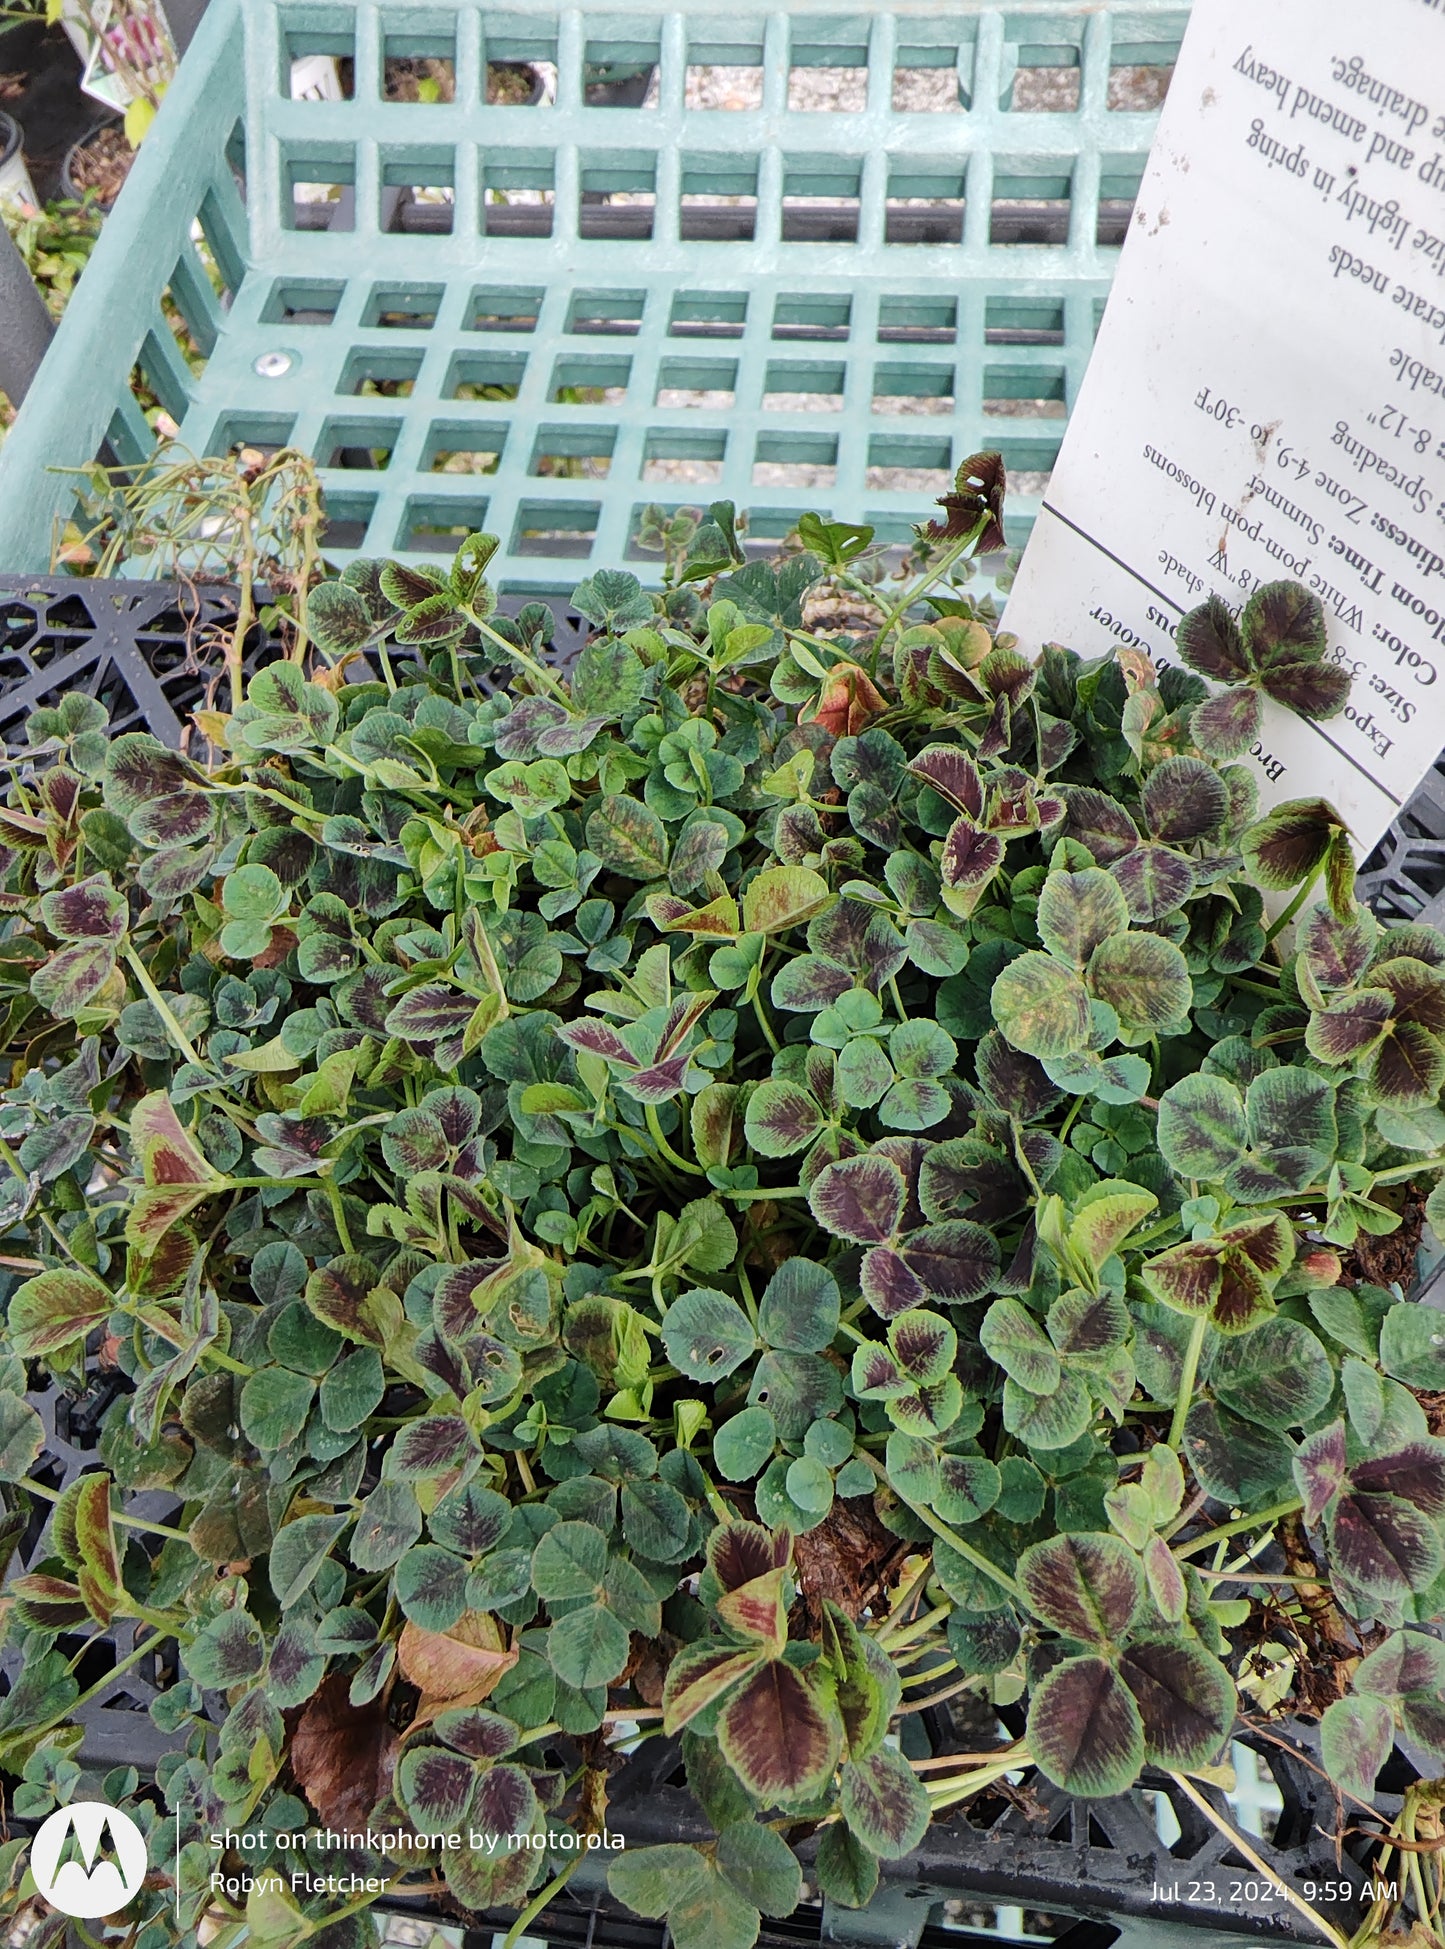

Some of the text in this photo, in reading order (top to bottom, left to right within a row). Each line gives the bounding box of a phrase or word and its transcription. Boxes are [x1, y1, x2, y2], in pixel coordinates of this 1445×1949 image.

[1232, 44, 1292, 111] heavy
[1331, 56, 1429, 136] drainage.
[1290, 86, 1367, 144] amend
[1245, 118, 1309, 178] spring
[1365, 131, 1415, 163] and
[1313, 167, 1336, 203] in
[1337, 179, 1410, 251] lightly
[1328, 245, 1445, 345] erate needs
[1389, 348, 1445, 399] table
[1250, 424, 1272, 447] to
[1366, 404, 1432, 454] 8-12"
[1276, 438, 1311, 481] 4-9,
[1330, 421, 1433, 514] Spreading
[1315, 472, 1368, 525] Zone
[1142, 444, 1437, 686] Color: White pom-pom blossoms
[1158, 550, 1204, 594] shade
[1245, 474, 1445, 647] loom Time: Summer
[1368, 674, 1417, 724] Size:
